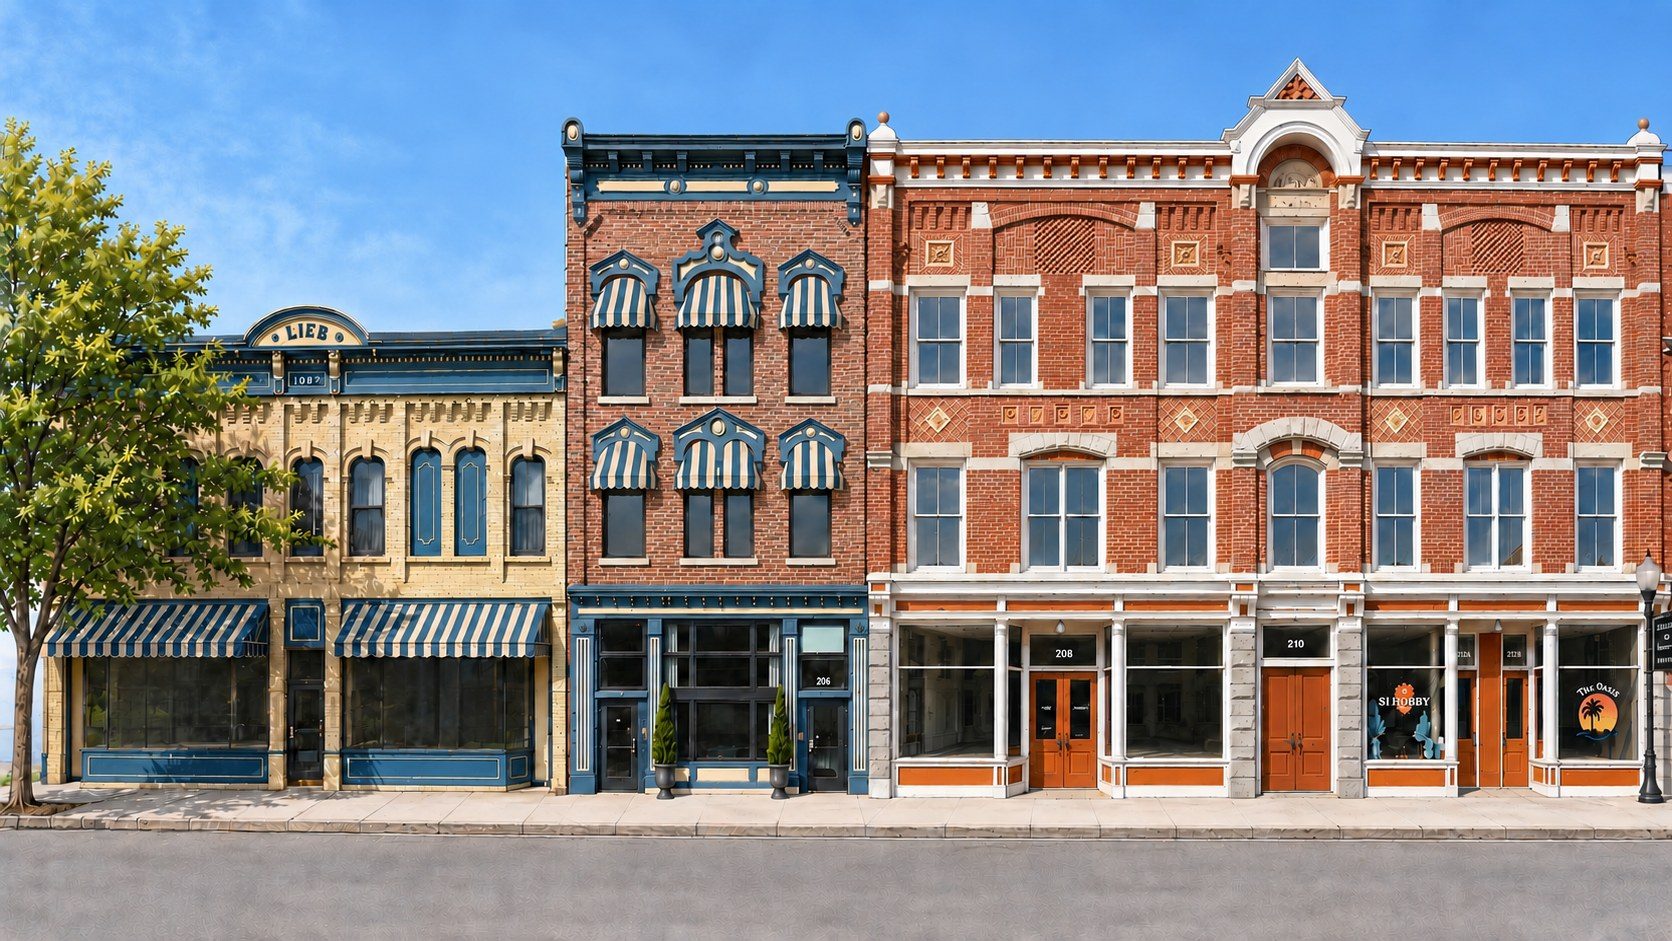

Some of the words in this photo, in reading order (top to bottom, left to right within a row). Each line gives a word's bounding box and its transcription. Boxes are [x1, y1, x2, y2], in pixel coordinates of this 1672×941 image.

[285, 323, 329, 341] LIEB
[1287, 639, 1305, 648] 210
[1055, 649, 1073, 658] 208
[816, 676, 831, 686] 206
[1378, 696, 1390, 707] SI
[1391, 696, 1431, 707] HOBBY
